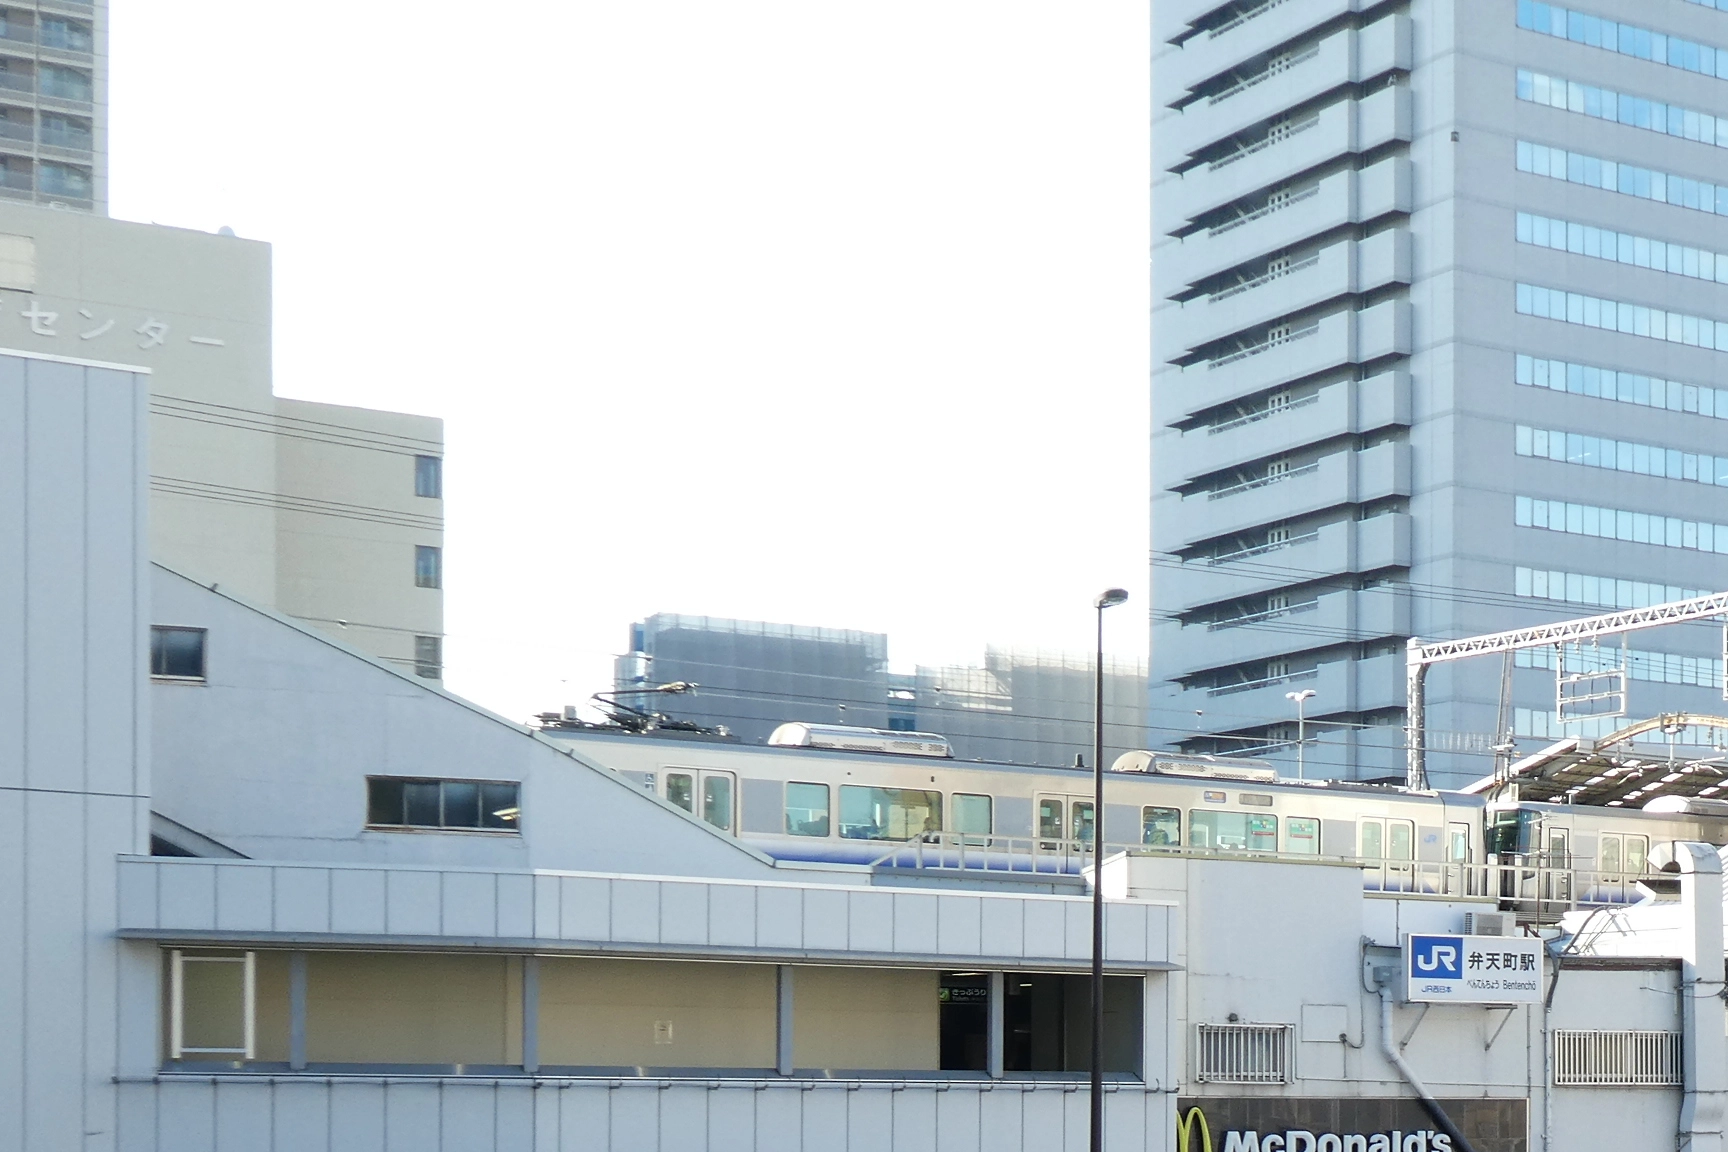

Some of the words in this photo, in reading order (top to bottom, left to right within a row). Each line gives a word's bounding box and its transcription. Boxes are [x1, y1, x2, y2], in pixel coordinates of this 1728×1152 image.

[0, 299, 226, 349] センター
[1417, 945, 1456, 971] JR
[1468, 952, 1535, 971] 弁天町駅
[1421, 985, 1452, 993] JR西日本
